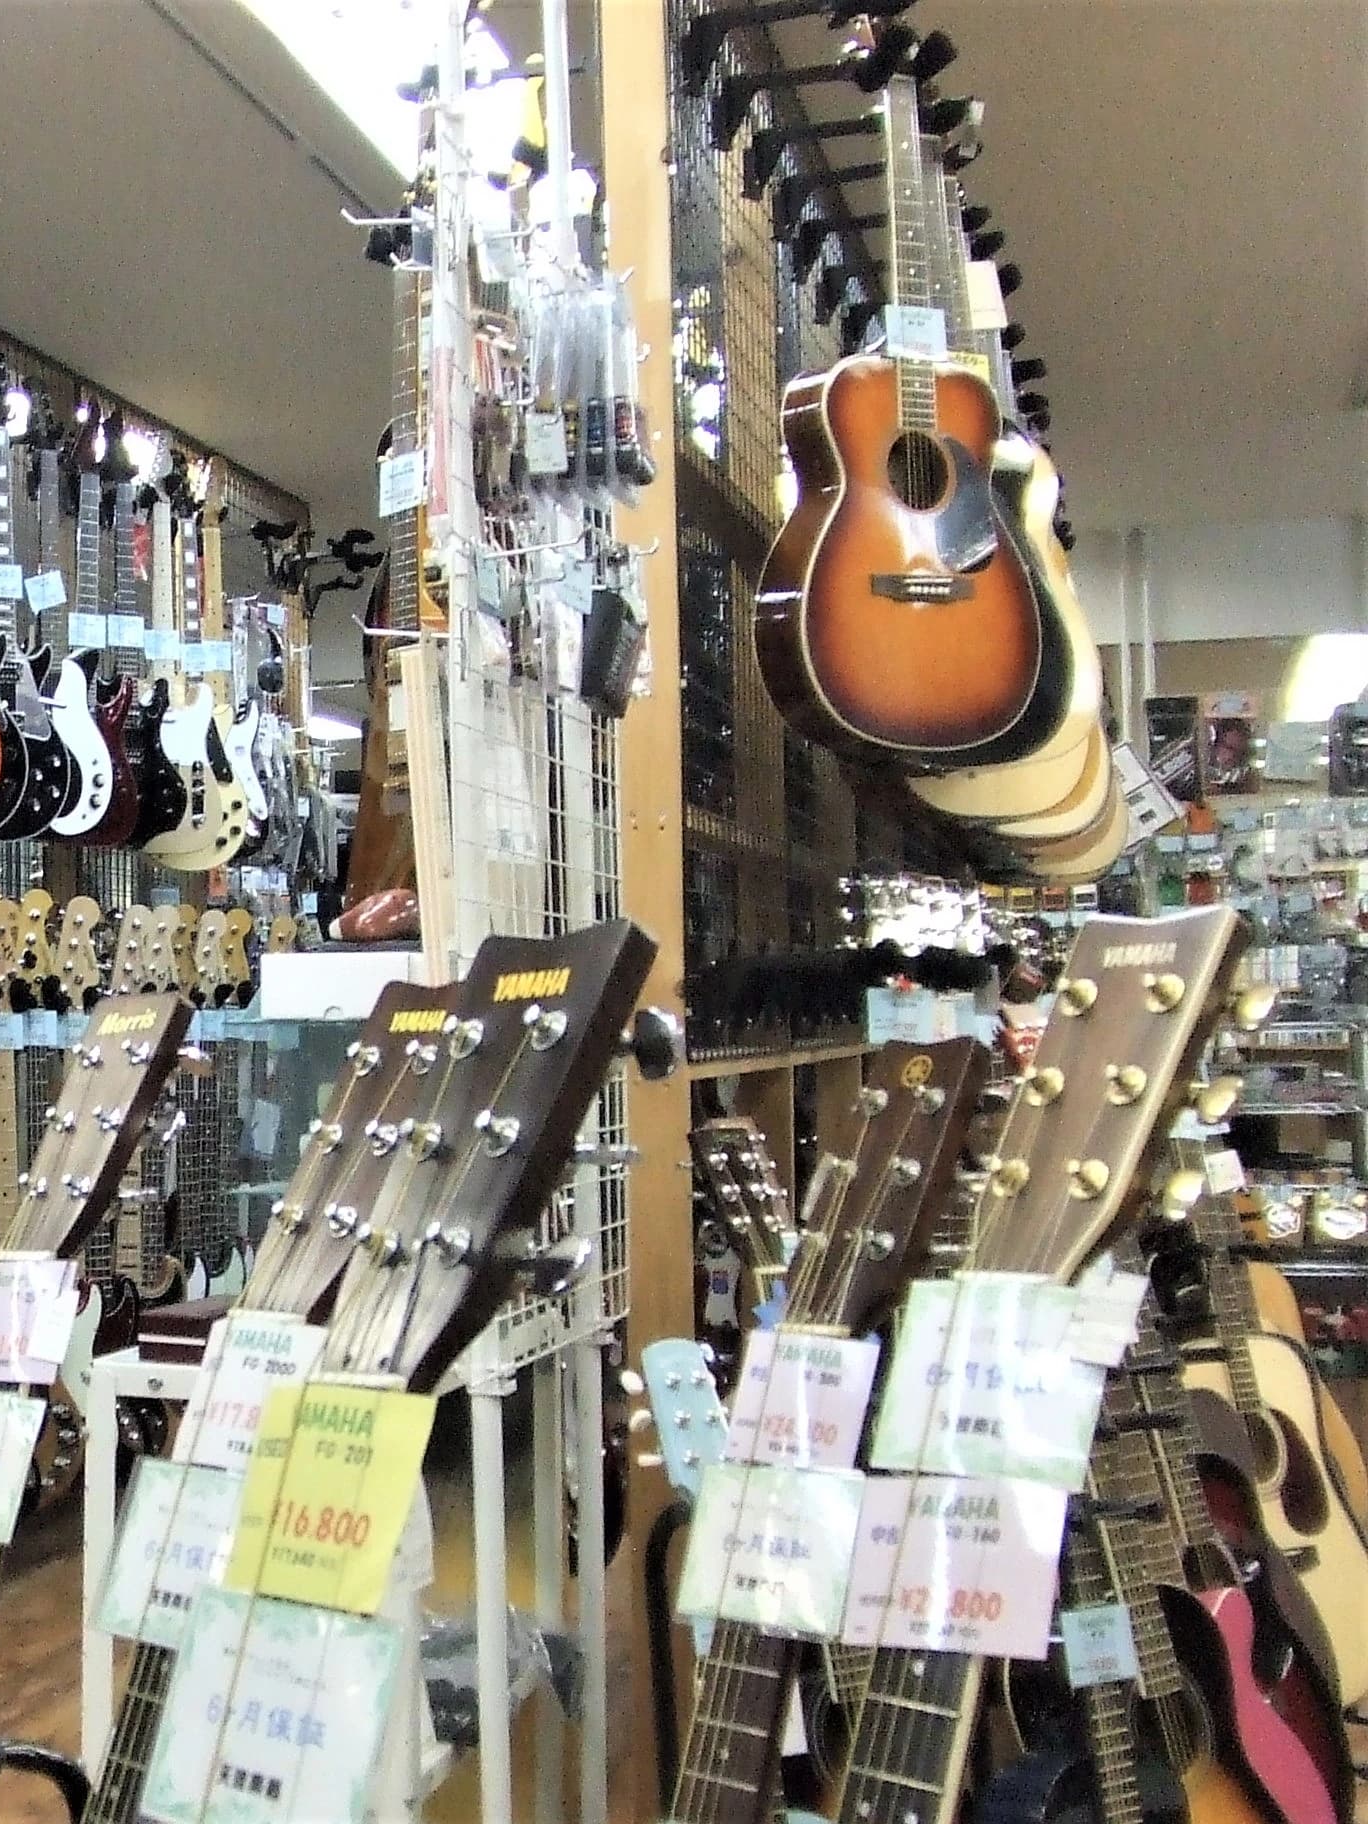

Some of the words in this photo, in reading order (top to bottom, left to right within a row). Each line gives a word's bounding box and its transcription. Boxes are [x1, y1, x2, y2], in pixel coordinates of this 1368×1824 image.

[1102, 941, 1177, 968] YAMAHA
[493, 966, 572, 1003] YAMAHA
[96, 1007, 158, 1036] Morris
[389, 1009, 447, 1033] YAMAHA
